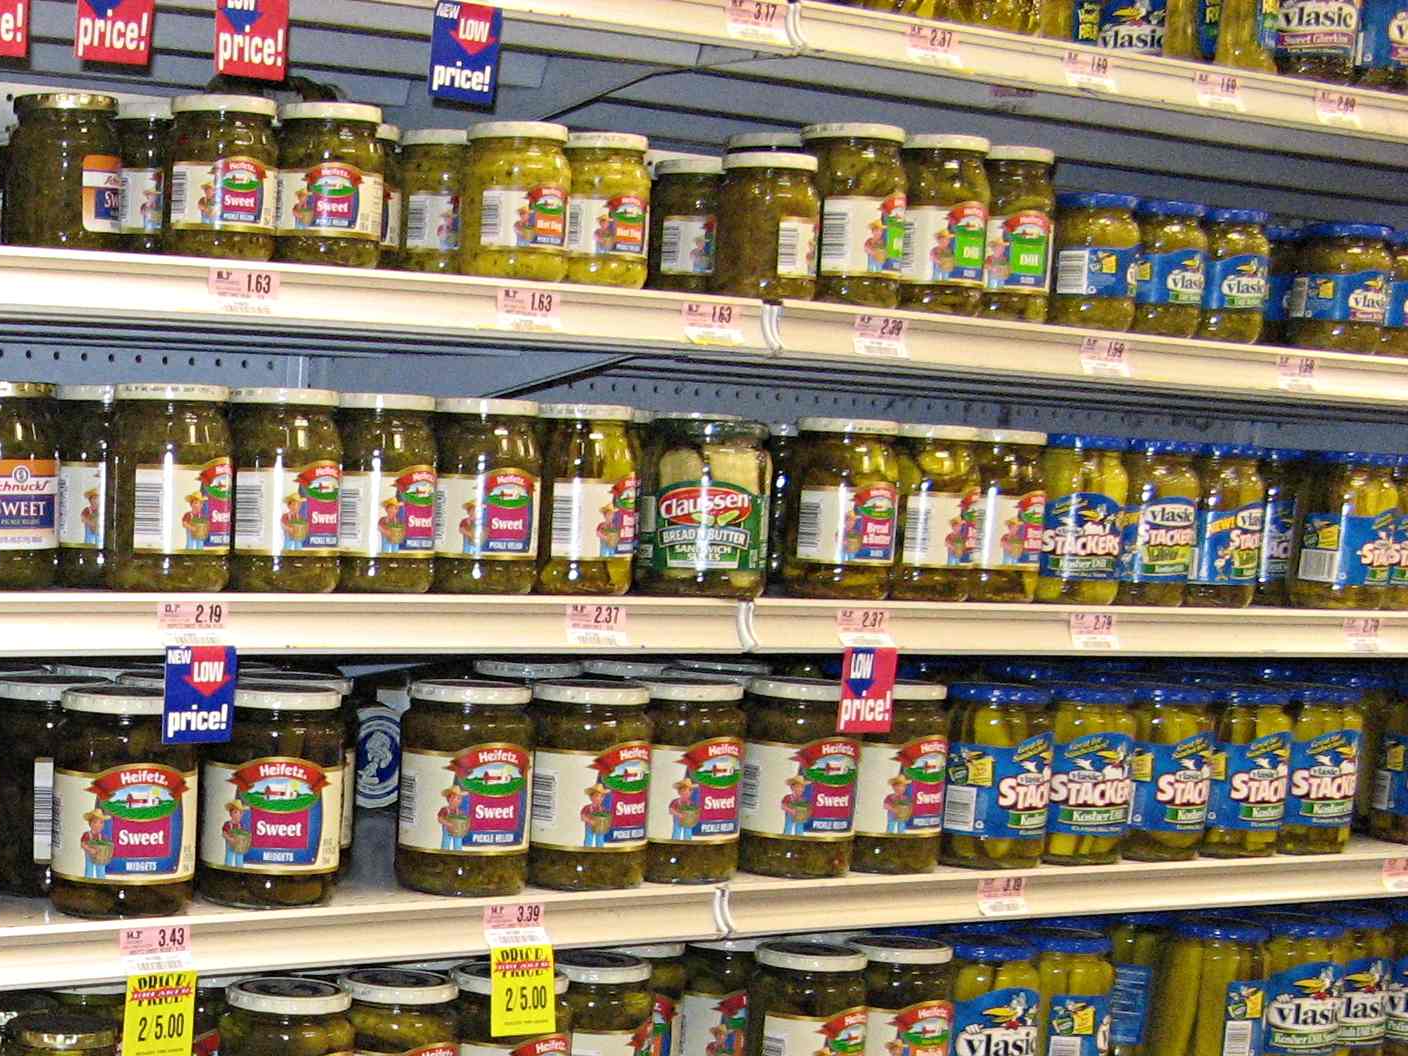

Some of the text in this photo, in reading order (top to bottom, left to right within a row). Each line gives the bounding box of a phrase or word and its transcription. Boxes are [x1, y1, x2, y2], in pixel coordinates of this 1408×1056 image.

[437, 3, 489, 42] NEW LOW
[77, 14, 146, 51] price!
[219, 31, 283, 67] price!
[432, 61, 490, 93] price!
[223, 195, 255, 207] Sweet
[247, 273, 271, 293] 1.63
[531, 293, 552, 312] 1.63
[711, 305, 732, 323] 1.63
[660, 492, 750, 519] Claussen
[491, 517, 523, 531] Sweet
[663, 528, 746, 546] BREAD BUTTER
[1041, 530, 1121, 555] STACKERS
[195, 605, 222, 624] 2.19
[594, 606, 620, 624] 2.37
[167, 649, 224, 683] NEW LOW
[850, 654, 872, 680] LOW
[840, 694, 890, 730] price!
[167, 711, 227, 742] price!
[475, 804, 514, 820] Sweet
[704, 796, 736, 812] Sweet
[119, 829, 164, 846] Sweet
[256, 820, 302, 837] Sweet
[126, 859, 157, 872] MIDGETS
[263, 850, 294, 862] MIDGETS
[517, 906, 540, 922] 3.39
[158, 928, 185, 947] 3.43
